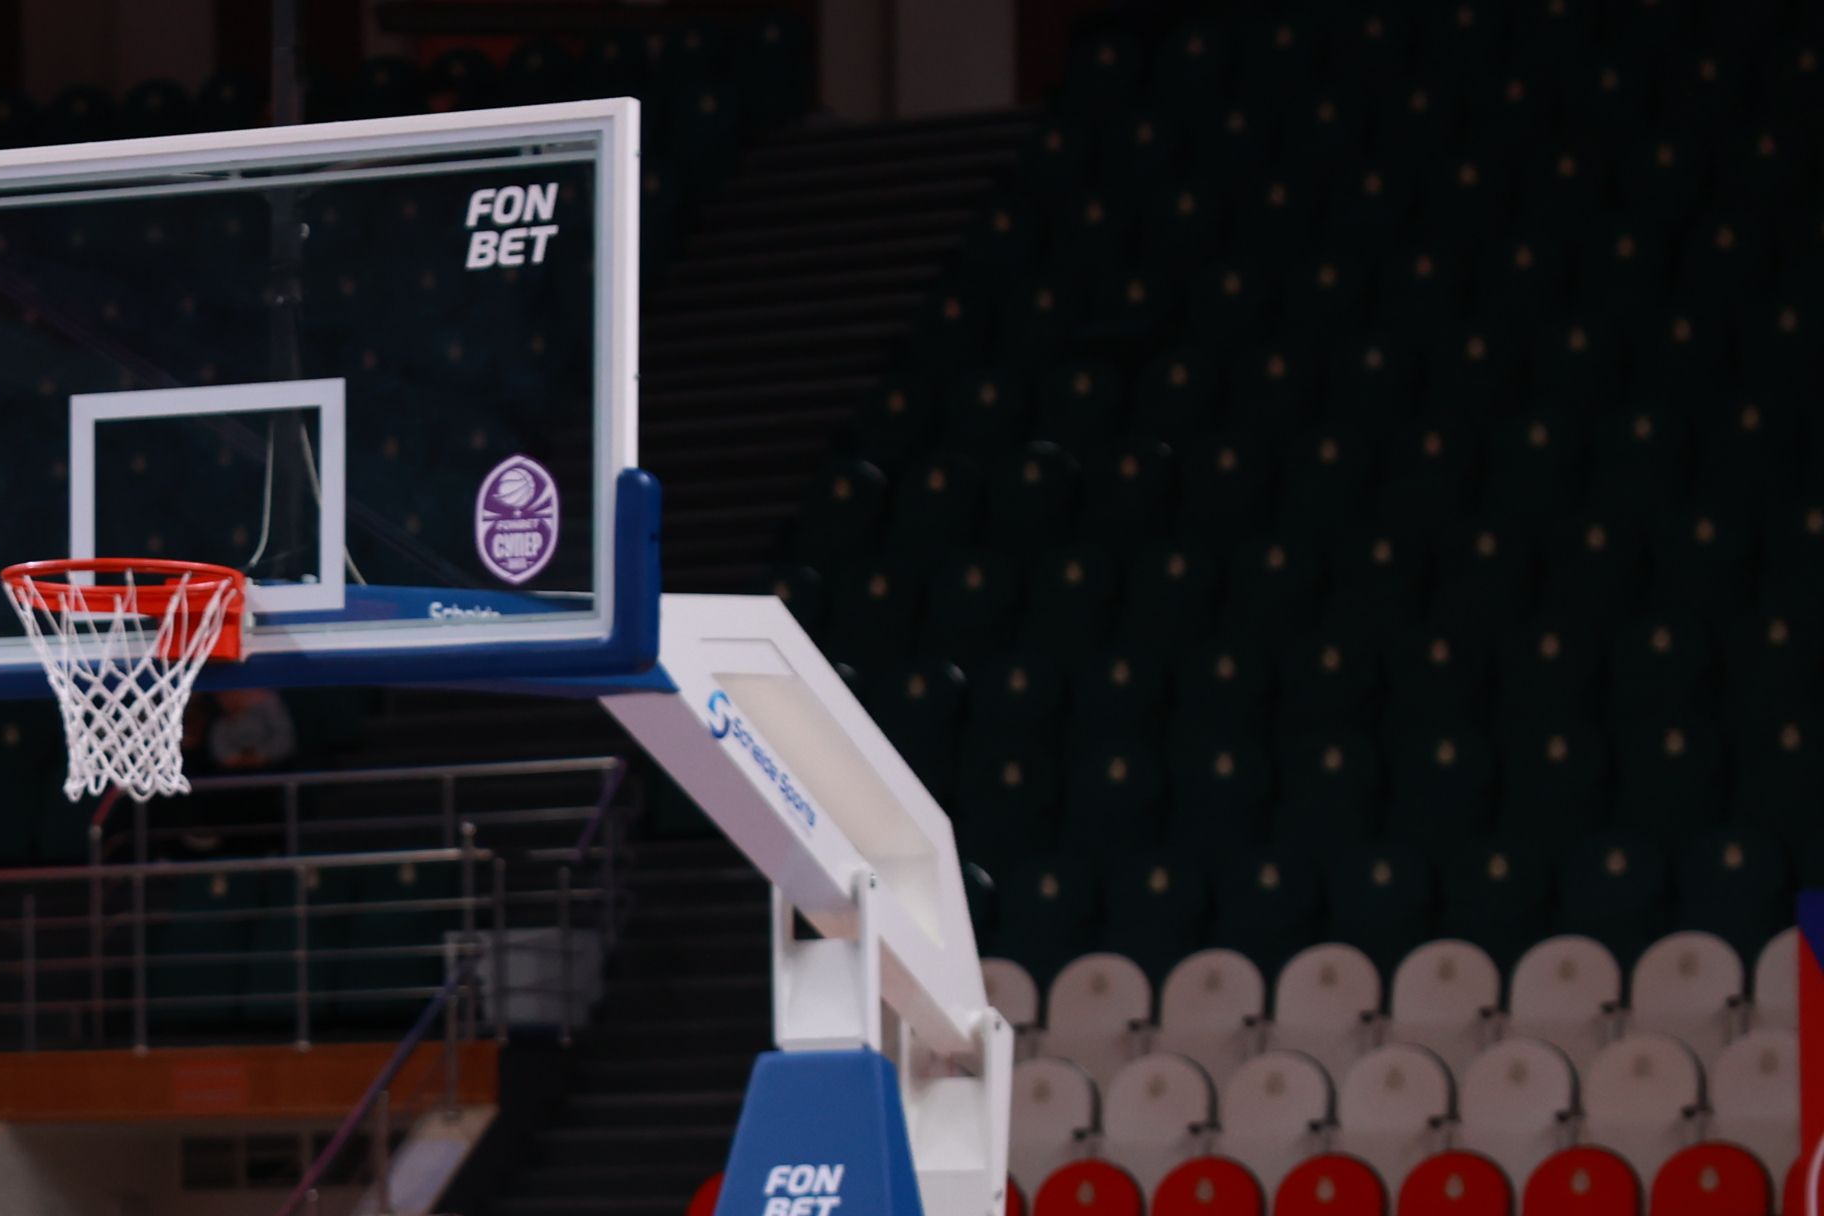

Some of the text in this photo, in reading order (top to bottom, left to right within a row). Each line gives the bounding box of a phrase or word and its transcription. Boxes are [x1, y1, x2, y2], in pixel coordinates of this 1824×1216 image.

[465, 182, 558, 228] FON
[464, 223, 559, 270] BET
[764, 1163, 845, 1197] FON
